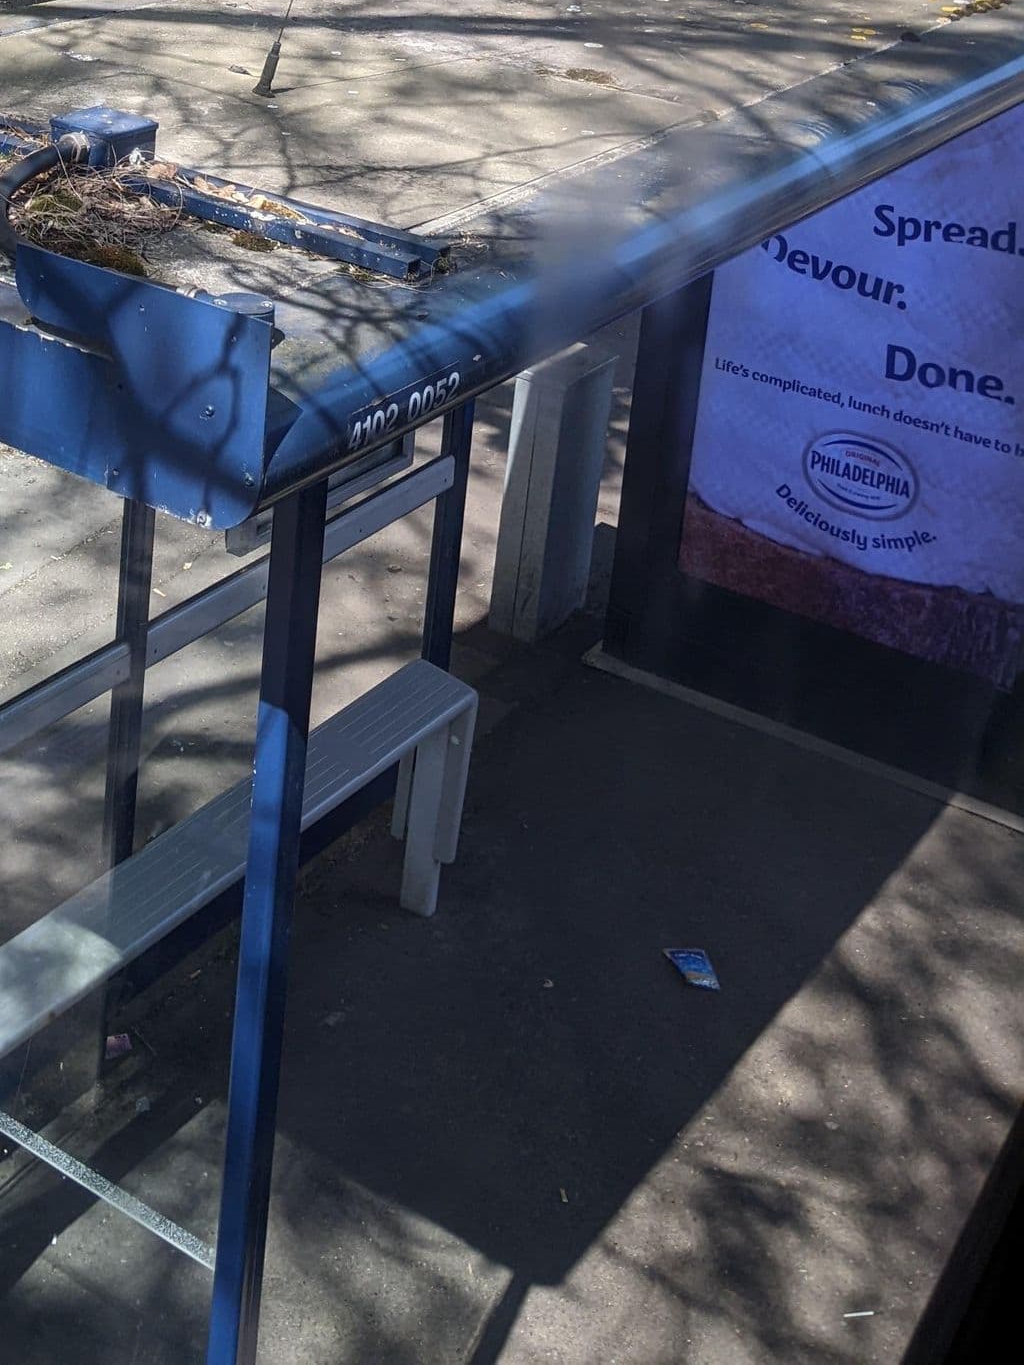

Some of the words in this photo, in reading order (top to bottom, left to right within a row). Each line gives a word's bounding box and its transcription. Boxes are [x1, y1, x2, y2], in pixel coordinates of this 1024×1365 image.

[872, 204, 1024, 257] Spread.
[715, 357, 750, 379] Life's
[752, 370, 845, 409] complicated,
[848, 397, 890, 419] lunch
[893, 408, 951, 436] doesn't
[954, 425, 992, 449] have
[994, 439, 1011, 453] to
[885, 343, 1016, 406] Done.
[348, 403, 399, 450] 4102
[408, 371, 460, 423] 0052
[810, 451, 910, 499] PHILADELPHIA
[776, 484, 868, 551] Deliciously
[872, 531, 936, 553] simple.
